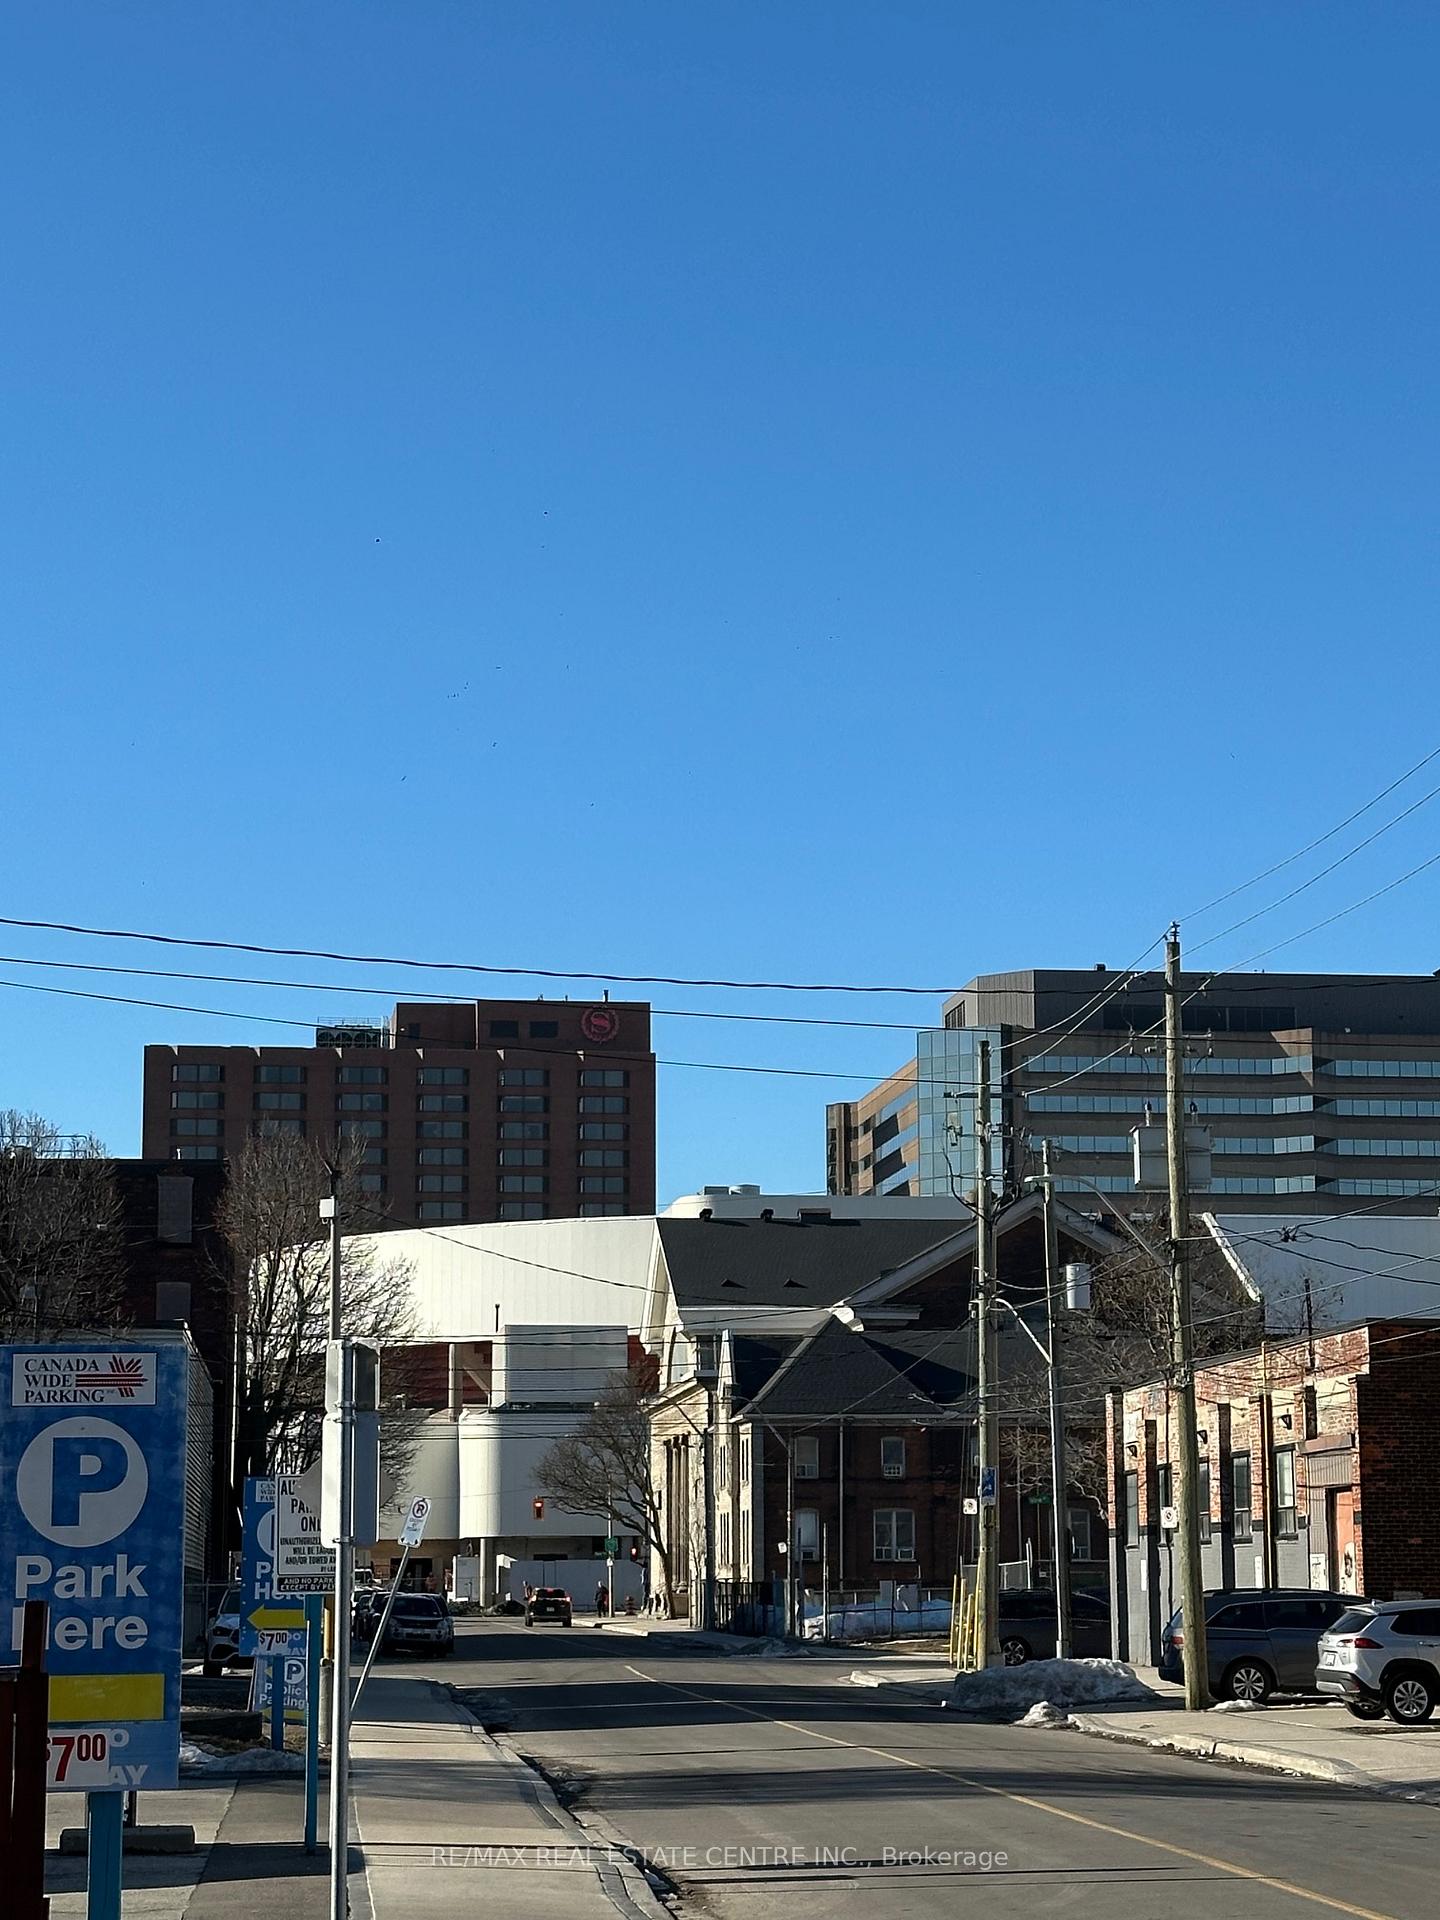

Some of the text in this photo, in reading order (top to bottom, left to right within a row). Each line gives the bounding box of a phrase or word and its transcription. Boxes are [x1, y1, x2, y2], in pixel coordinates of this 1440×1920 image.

[24, 1358, 100, 1372] CANADA
[24, 1374, 73, 1388] WIDE
[24, 1389, 105, 1403] PARKING
[51, 1437, 129, 1527] P
[15, 1553, 149, 1599] Park
[45, 1733, 106, 1782] 700
[109, 1764, 149, 1785] AY
